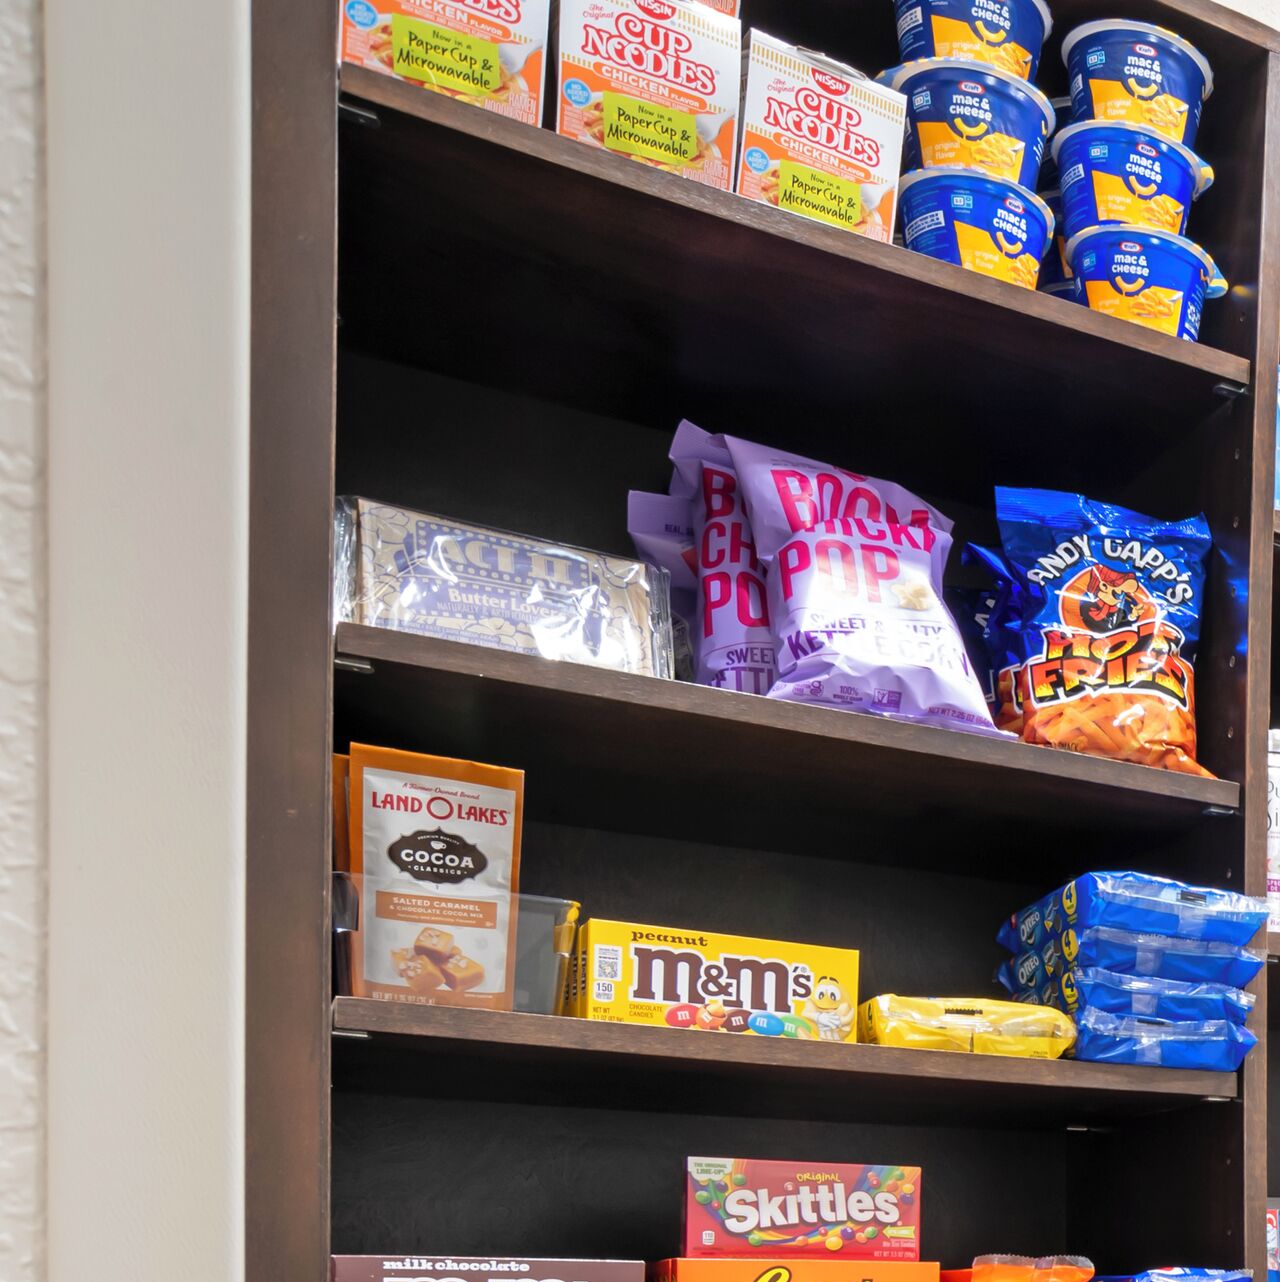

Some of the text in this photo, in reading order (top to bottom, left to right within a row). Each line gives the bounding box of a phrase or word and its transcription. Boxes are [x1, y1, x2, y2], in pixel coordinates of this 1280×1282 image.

[636, 0, 672, 17] NISSIN
[1001, 6, 1009, 19] &
[616, 13, 692, 56] CUP
[408, 30, 494, 73] Paper Cup &
[581, 24, 715, 95] NOODLES
[1127, 56, 1161, 72] mac &
[396, 47, 491, 90] Microwavable
[815, 73, 847, 92] NISSIN
[601, 66, 670, 97] CHICKEN
[672, 94, 699, 107] FLAVOR
[638, 105, 654, 116] Now
[795, 87, 861, 131] CUP
[952, 94, 990, 110] mac &
[617, 107, 691, 142] Paper Cup &
[764, 97, 880, 167] NOODLES
[607, 123, 688, 159] Microwavable
[780, 136, 840, 165] CHICKEN
[1130, 154, 1161, 173] mac &
[791, 174, 857, 208] Paper Cup &
[781, 190, 853, 224] Microwavable
[996, 208, 1027, 231] mac &
[1114, 255, 1147, 266] mac &
[433, 536, 573, 585] ACT II
[778, 540, 900, 603] POP
[1027, 534, 1192, 604] ANDY CAPP'S
[448, 588, 508, 610] Butter
[1046, 622, 1176, 660] HOT
[1029, 652, 1185, 699] FRIES
[372, 791, 508, 826] LAND O LAKES
[400, 849, 474, 869] COCOA
[414, 865, 462, 875] CLASSICS
[393, 897, 481, 912] SALTED CARAMEL
[396, 905, 441, 915] CHOCOLATE
[631, 930, 708, 947] peanut
[1020, 911, 1040, 942] OREO
[1018, 955, 1040, 985] OREO
[1065, 973, 1074, 992] 4
[597, 982, 612, 992] 150
[629, 1003, 662, 1012] CHOCOLATE
[724, 1182, 900, 1233] Skittles
[383, 1259, 530, 1272] milk chocolate
